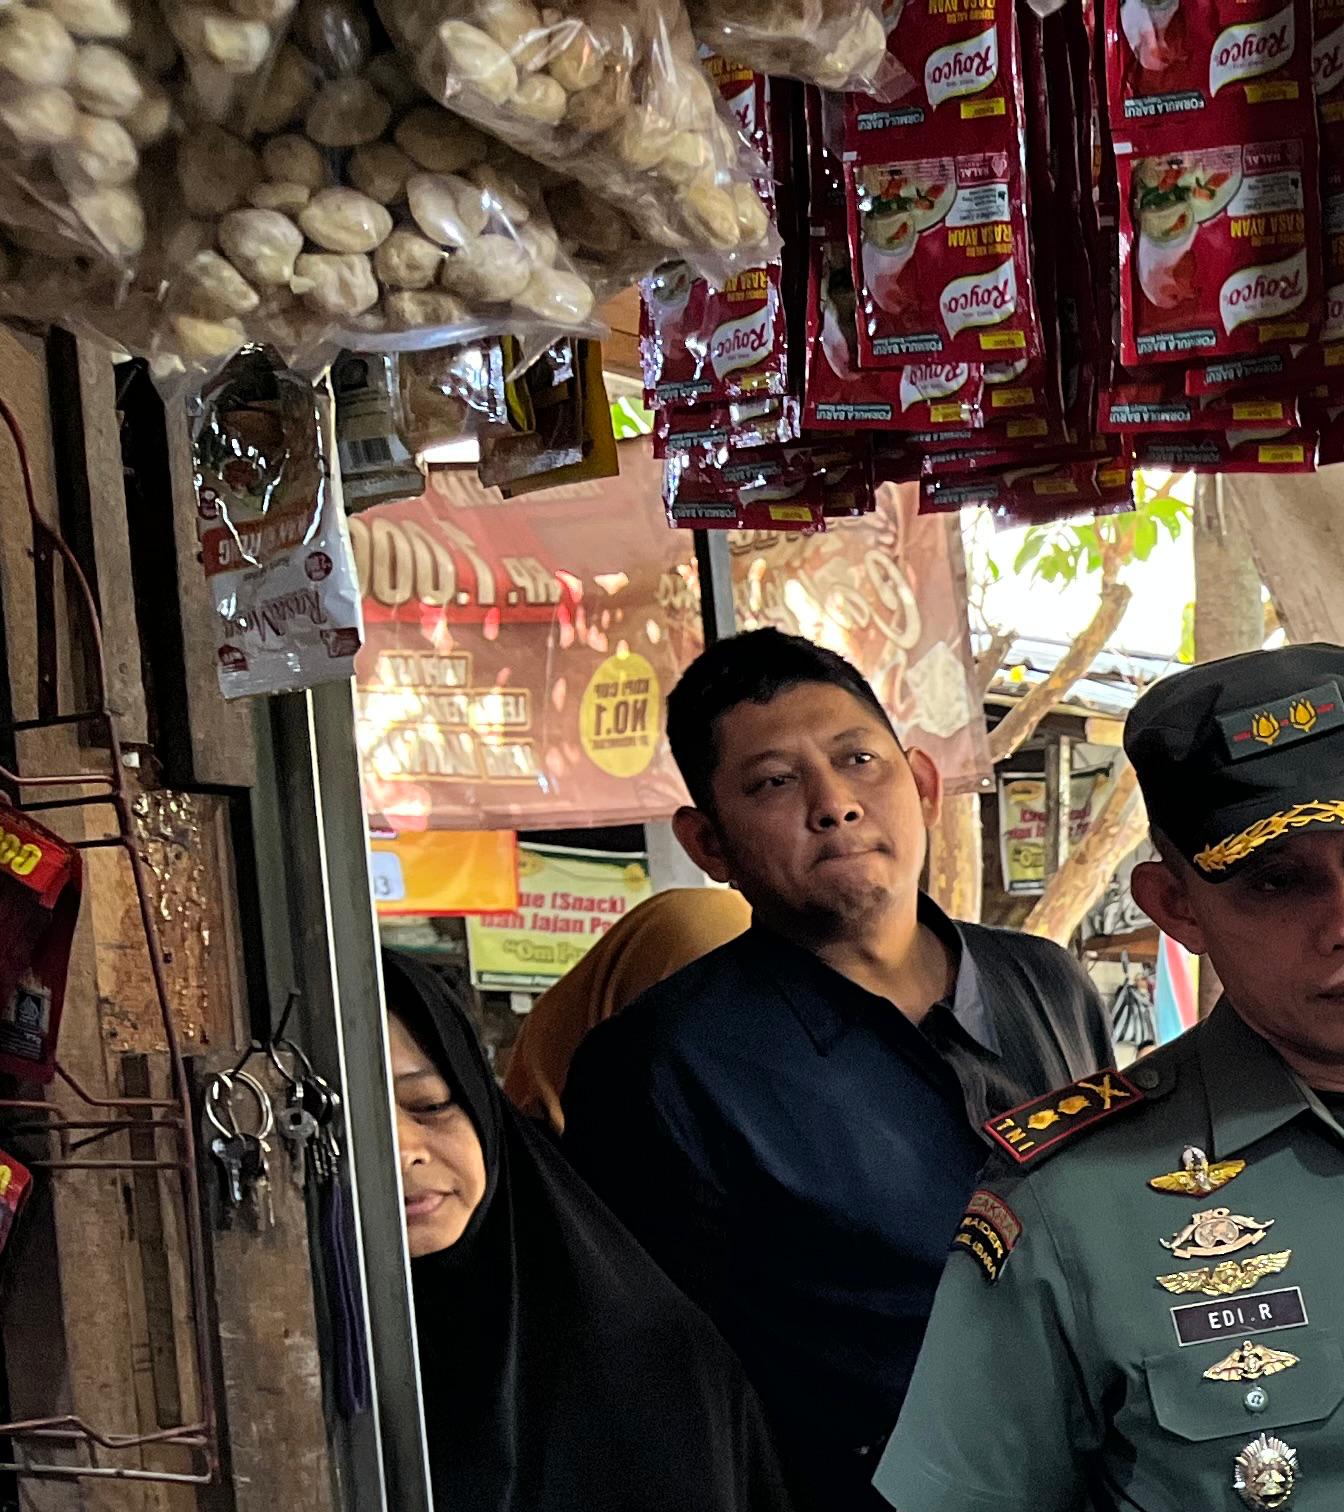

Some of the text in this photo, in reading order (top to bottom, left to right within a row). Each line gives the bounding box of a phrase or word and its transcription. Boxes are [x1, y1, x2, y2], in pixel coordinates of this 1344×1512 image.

[1218, 25, 1288, 66] Royco
[932, 46, 992, 83] Royco
[1157, 99, 1204, 113] FORMULA
[959, 167, 989, 178] HALAL
[948, 224, 1012, 246] RASA AYAM
[1230, 215, 1304, 238] RASA AYAM
[947, 279, 1012, 312] Royco
[1227, 268, 1302, 306] Royco
[718, 323, 767, 357] Royco
[901, 339, 942, 351] FORMULA
[1169, 336, 1216, 349] FORMULA
[854, 409, 891, 419] FORMULA
[1142, 411, 1190, 422] FORMULA
[531, 913, 584, 933] Jajan
[997, 1119, 1035, 1152] TNI
